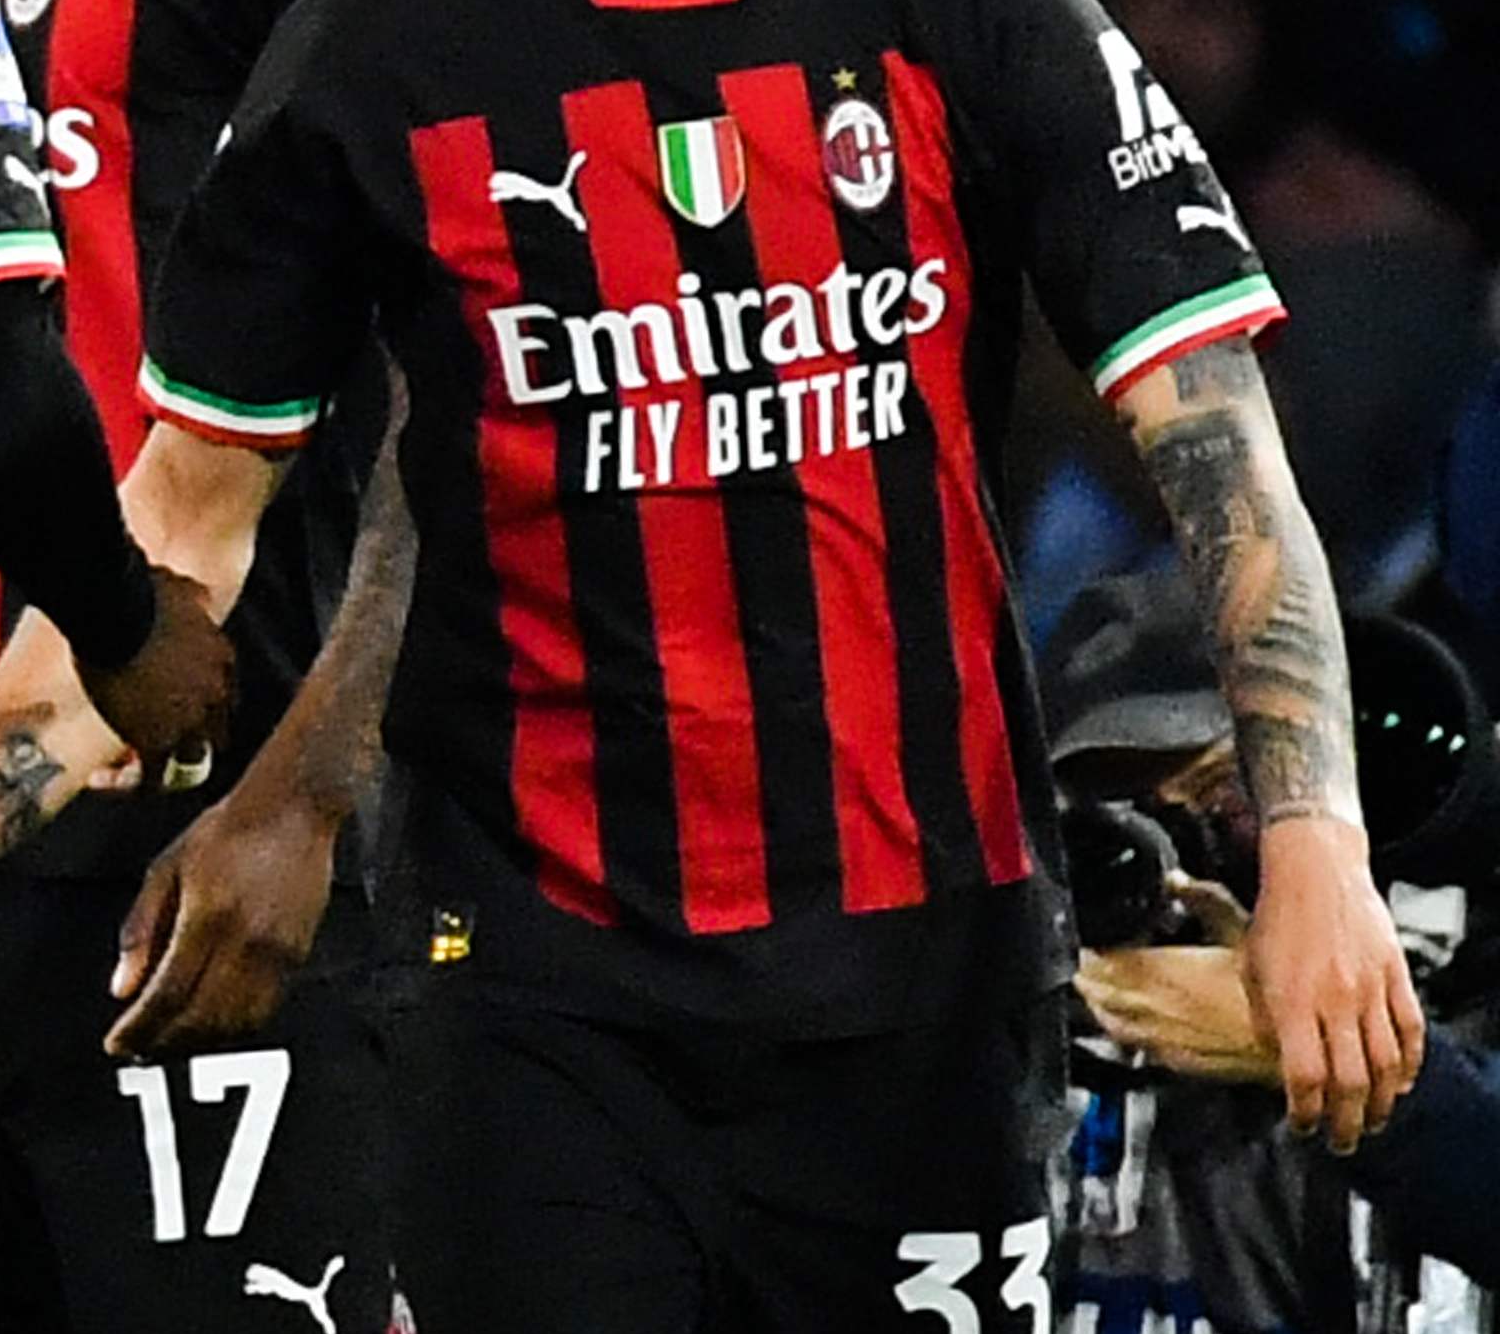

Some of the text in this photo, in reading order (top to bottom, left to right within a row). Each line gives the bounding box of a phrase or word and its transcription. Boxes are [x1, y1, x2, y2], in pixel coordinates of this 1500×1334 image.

[486, 258, 947, 405] Emirates
[584, 361, 907, 493] FLY BETTER
[118, 1049, 290, 1242] 17
